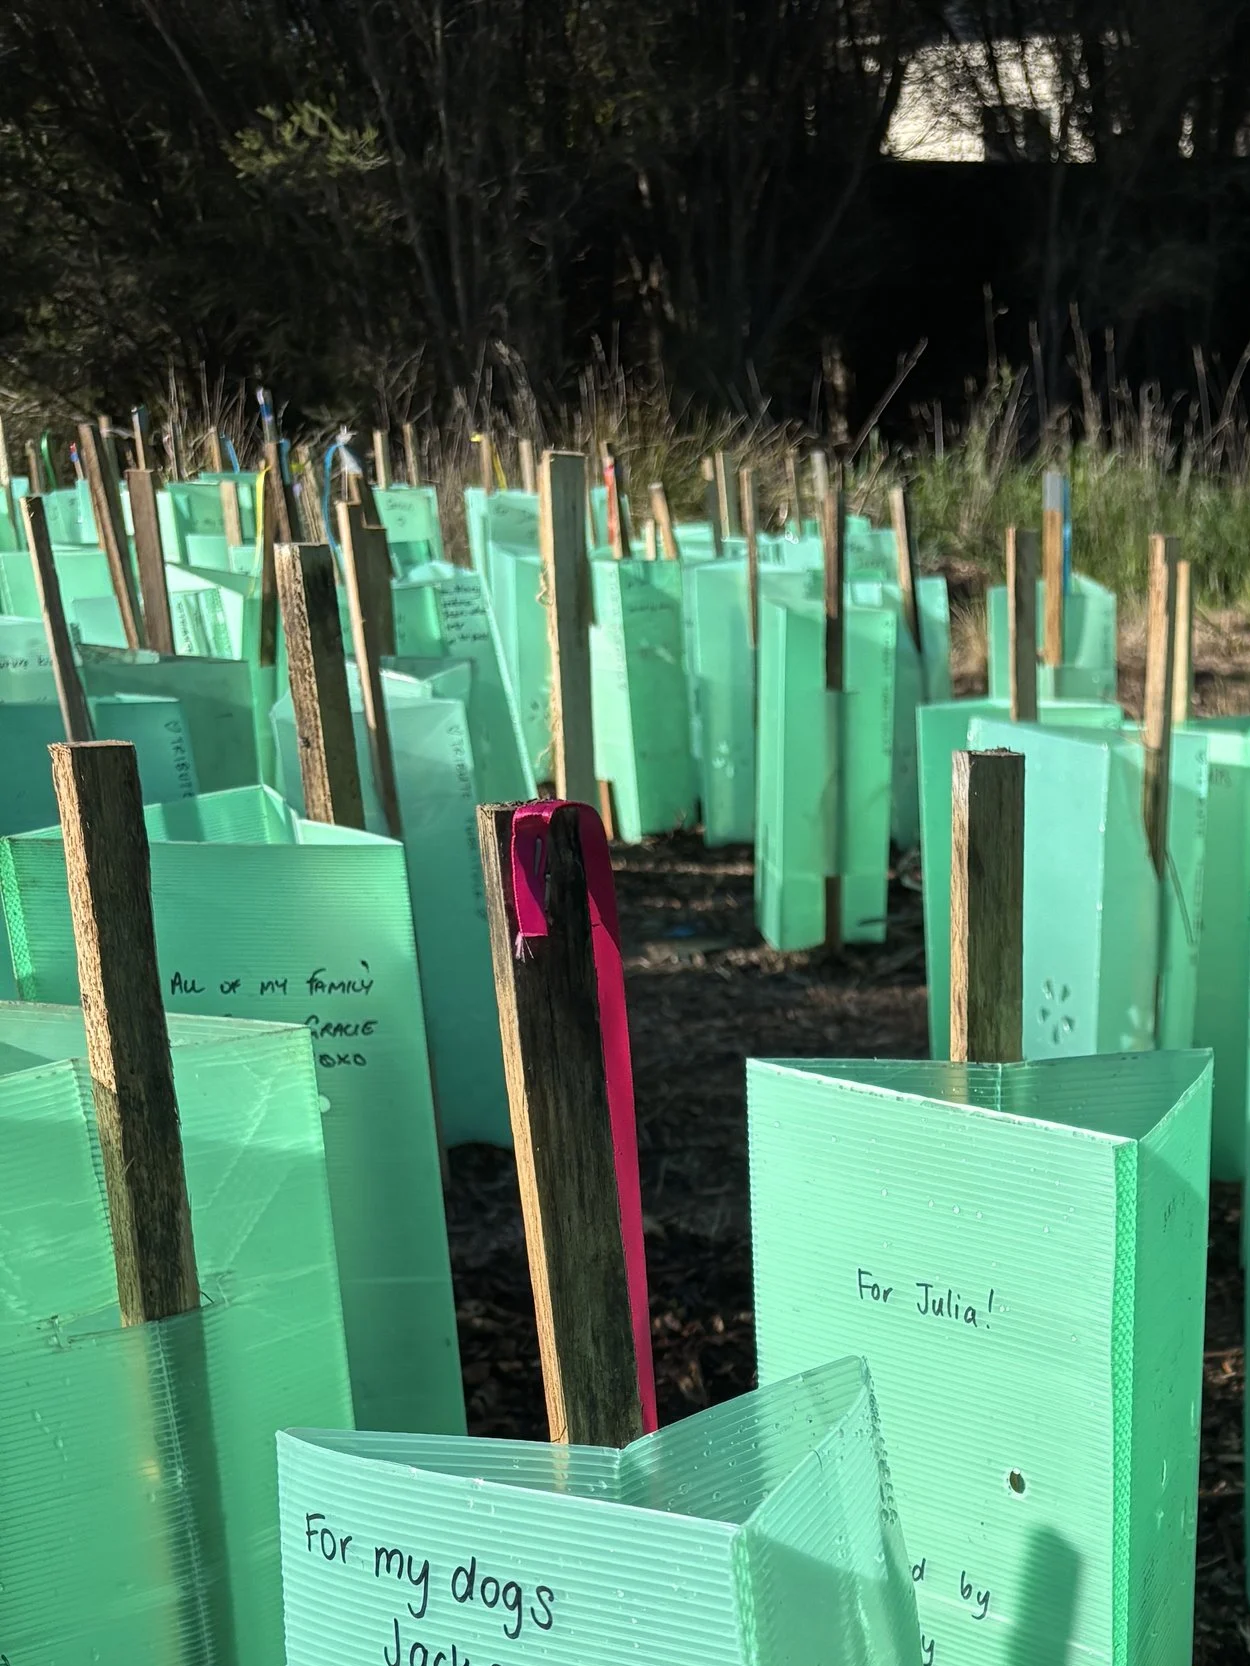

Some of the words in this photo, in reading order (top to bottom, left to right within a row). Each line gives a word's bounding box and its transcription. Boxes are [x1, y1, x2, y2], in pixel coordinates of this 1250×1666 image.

[858, 1267, 893, 1303] For
[915, 1282, 994, 1329] Julia!
[305, 1512, 353, 1564] For
[374, 1546, 430, 1619] my
[451, 1555, 555, 1640] dogs
[960, 1569, 991, 1621] by
